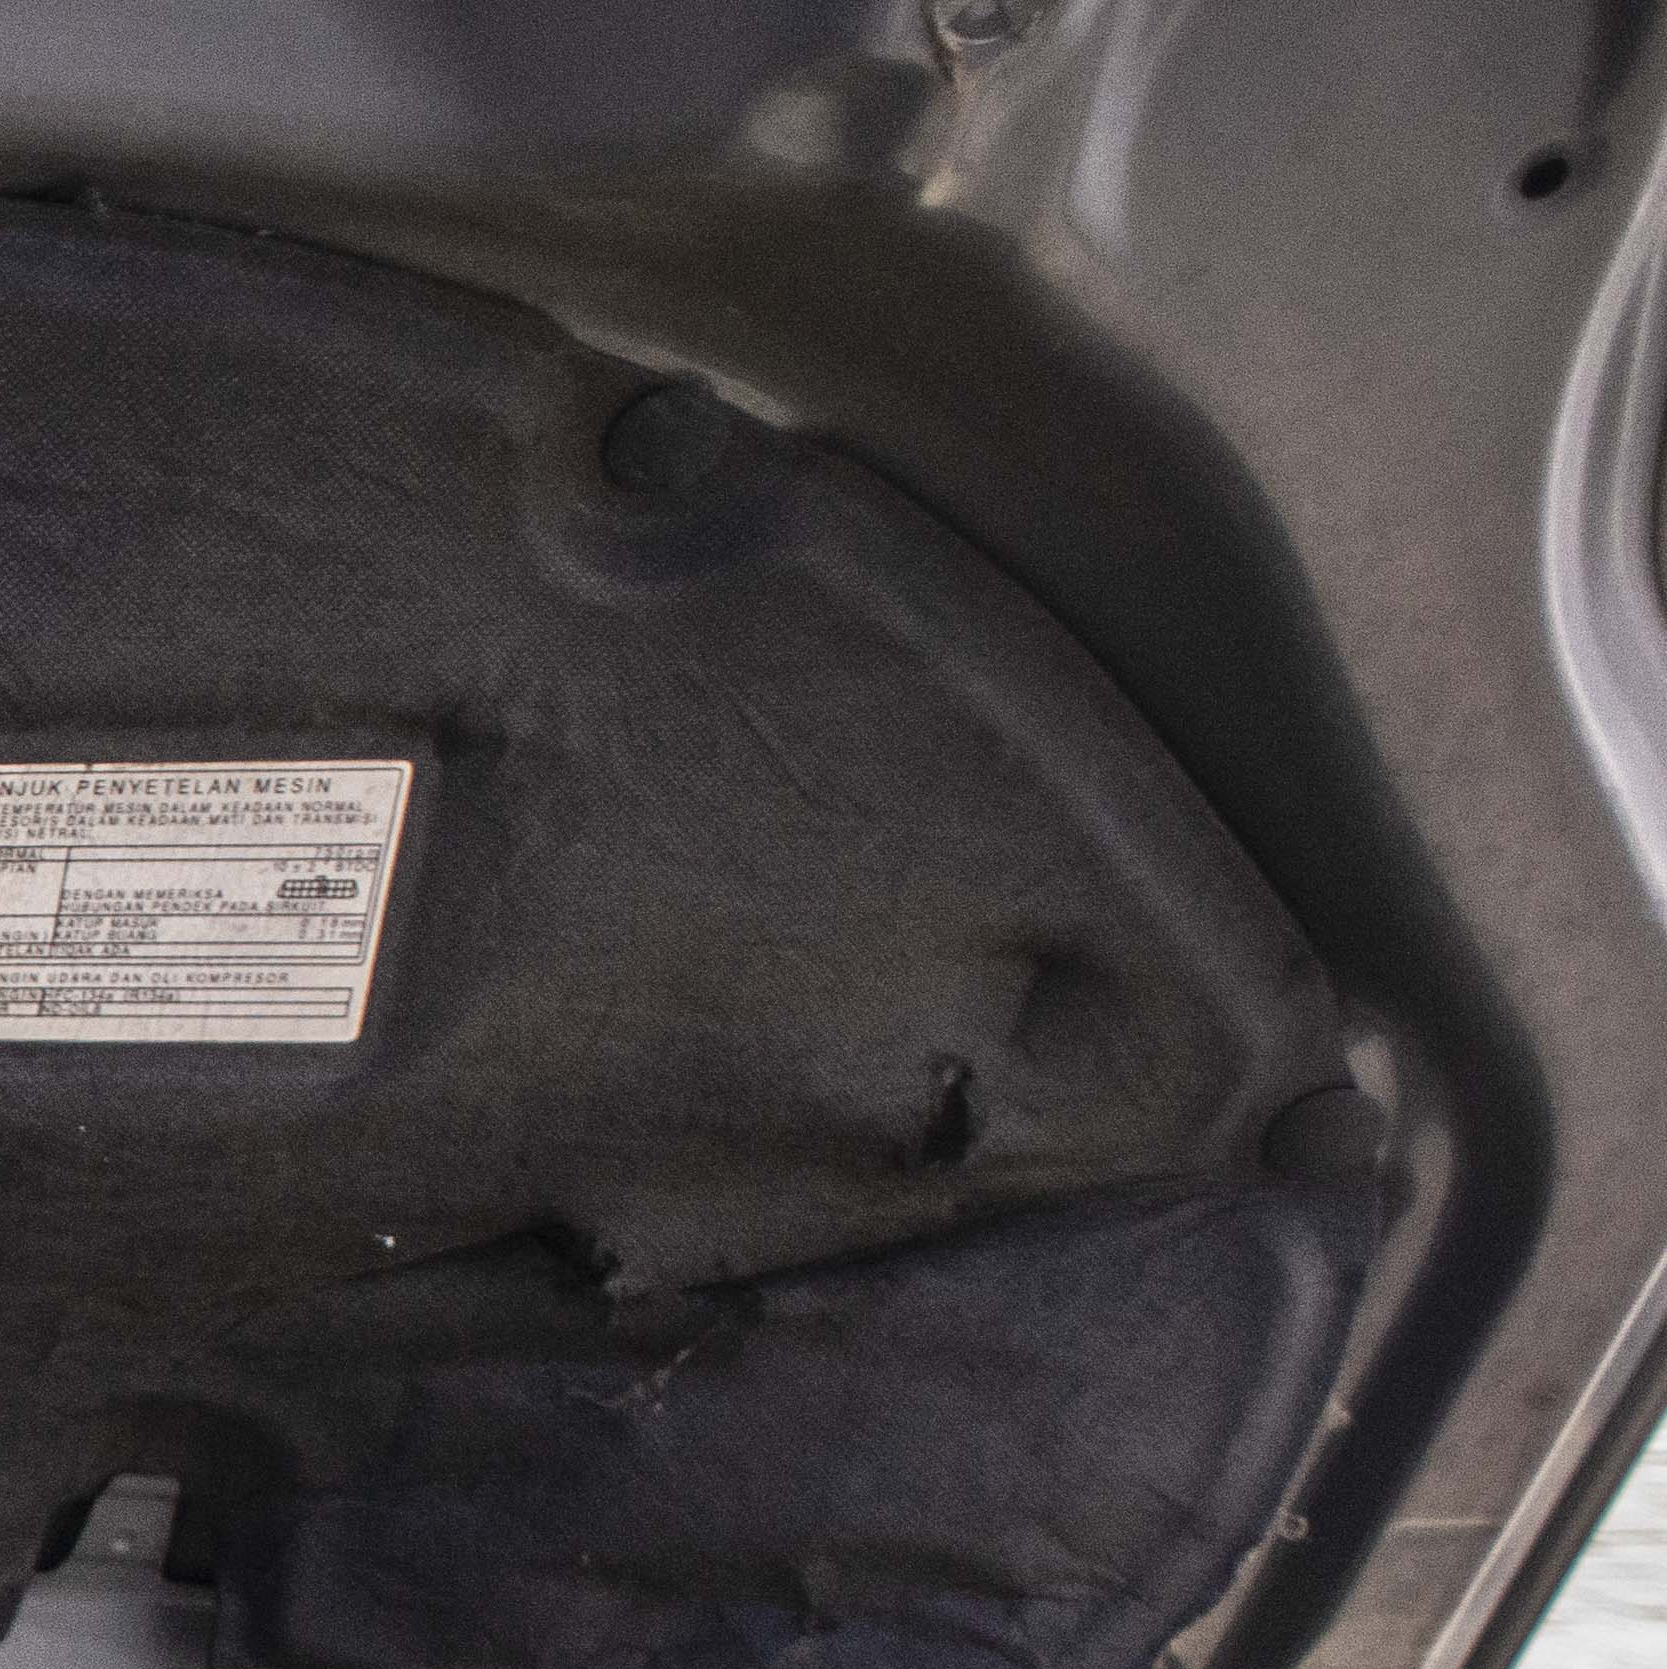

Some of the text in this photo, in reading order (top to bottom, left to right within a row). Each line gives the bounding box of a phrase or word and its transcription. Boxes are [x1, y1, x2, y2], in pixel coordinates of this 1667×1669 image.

[76, 778, 241, 796] PENYETELAN
[254, 776, 332, 794] MESIN
[104, 802, 151, 814] MESIN
[159, 802, 212, 813] DALAM
[222, 801, 294, 813] KEADAAN
[68, 815, 120, 827] DALAM
[127, 814, 200, 826] KEADAAN
[209, 814, 245, 825] MATI
[253, 814, 284, 825] DAN
[61, 888, 223, 900] DENGAN MEMERIKSA
[60, 901, 143, 913] HUBUNGAN
[153, 901, 212, 912] PENDEK
[219, 901, 258, 912] PADA
[56, 917, 103, 929] KATUP
[47, 972, 102, 983] UDARA
[109, 972, 142, 983] DAN
[151, 972, 178, 984] OLI
[186, 972, 290, 984] KOMPRESOR
